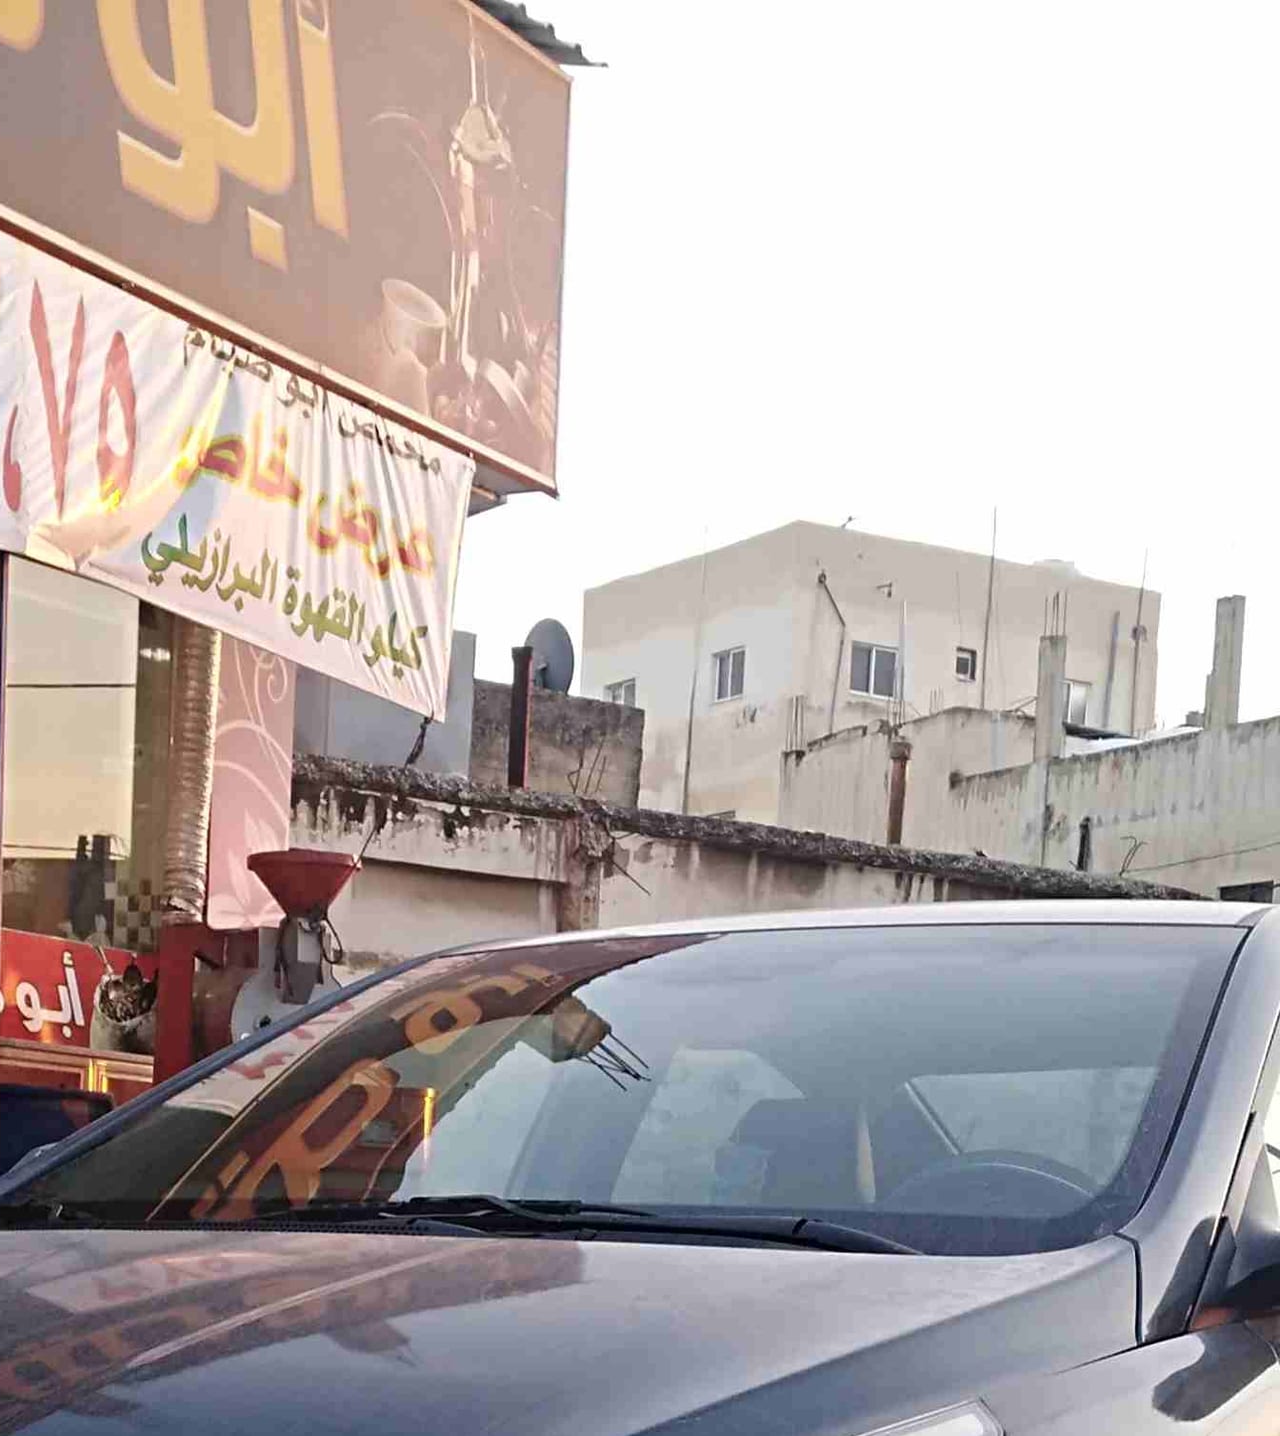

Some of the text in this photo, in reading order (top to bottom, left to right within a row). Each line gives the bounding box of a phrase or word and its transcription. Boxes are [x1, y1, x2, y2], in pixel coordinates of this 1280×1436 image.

[141, 512, 429, 679] كيلو القهوة البرازيلي
[16, 951, 85, 1039] أبو
